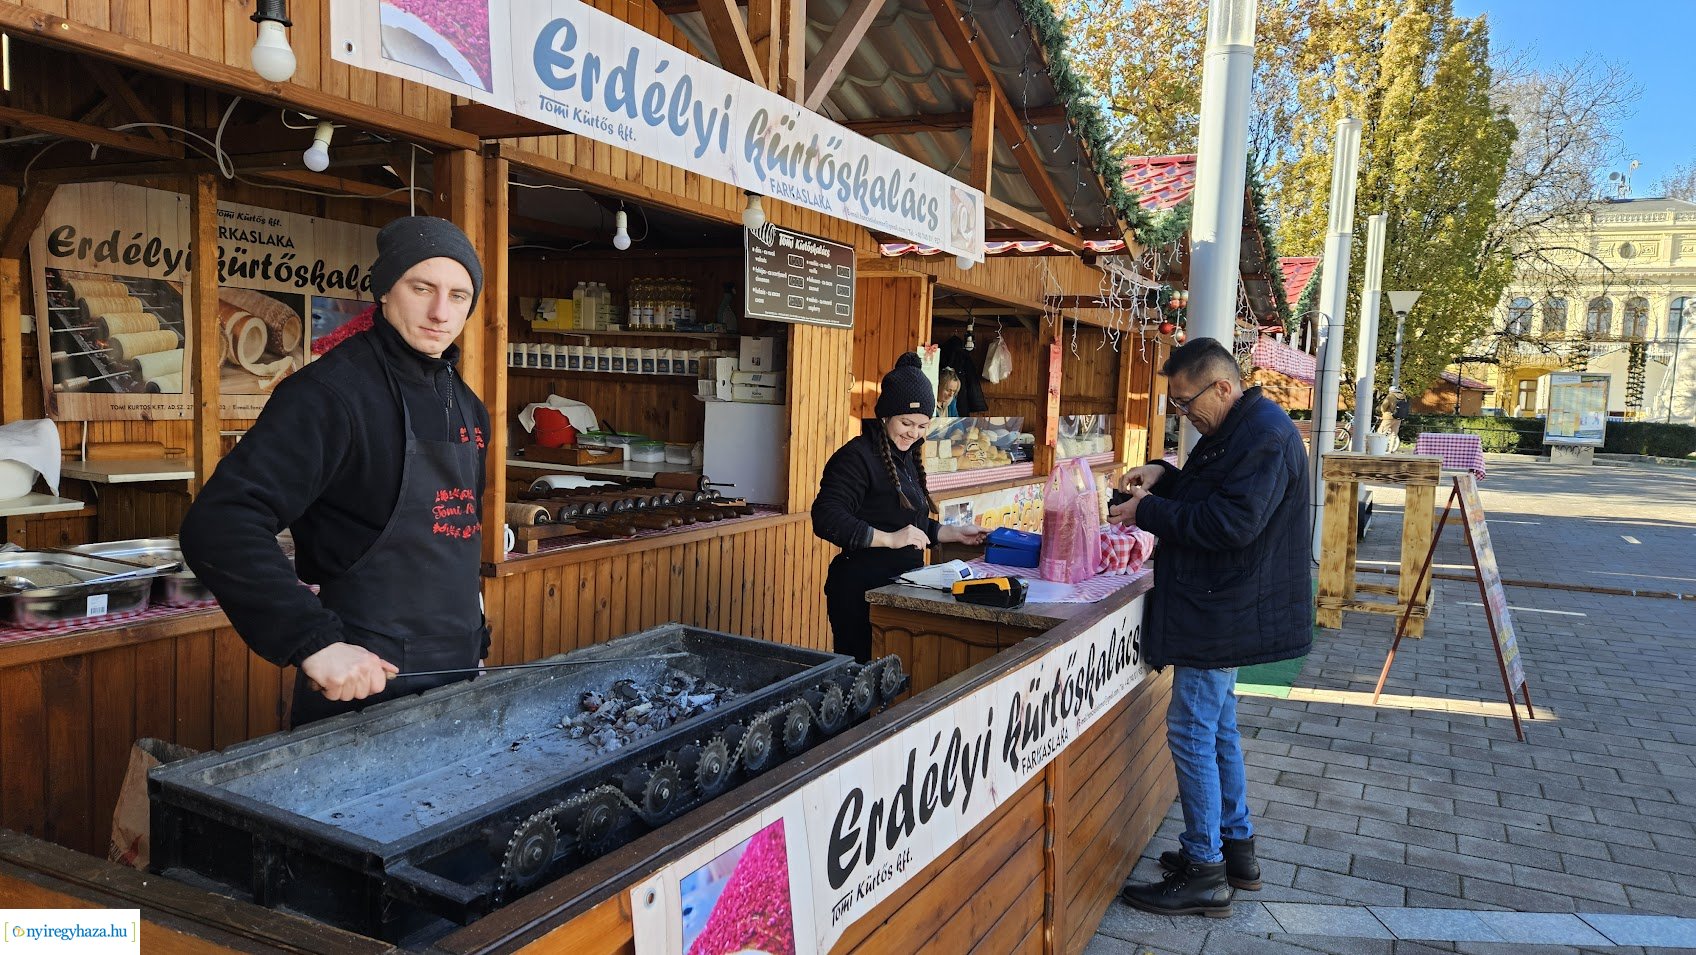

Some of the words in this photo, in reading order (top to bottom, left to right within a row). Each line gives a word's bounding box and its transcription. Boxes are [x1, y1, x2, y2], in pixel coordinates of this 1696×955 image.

[533, 17, 733, 159] Erdélyi
[744, 107, 939, 232] kürtőskalács
[539, 94, 569, 119] Tomi
[572, 109, 614, 136] Kürtős
[236, 212, 266, 225] Kürtős
[769, 177, 833, 212] FARKASLAKA
[48, 224, 192, 276] Erdélyi
[432, 504, 461, 520] Tomi
[826, 706, 994, 890] Erdélyi
[1002, 616, 1141, 773] kürtőskalács
[1021, 727, 1070, 776] FARKASLAKA
[831, 891, 853, 927] Tomi
[855, 863, 894, 900] Kürtős
